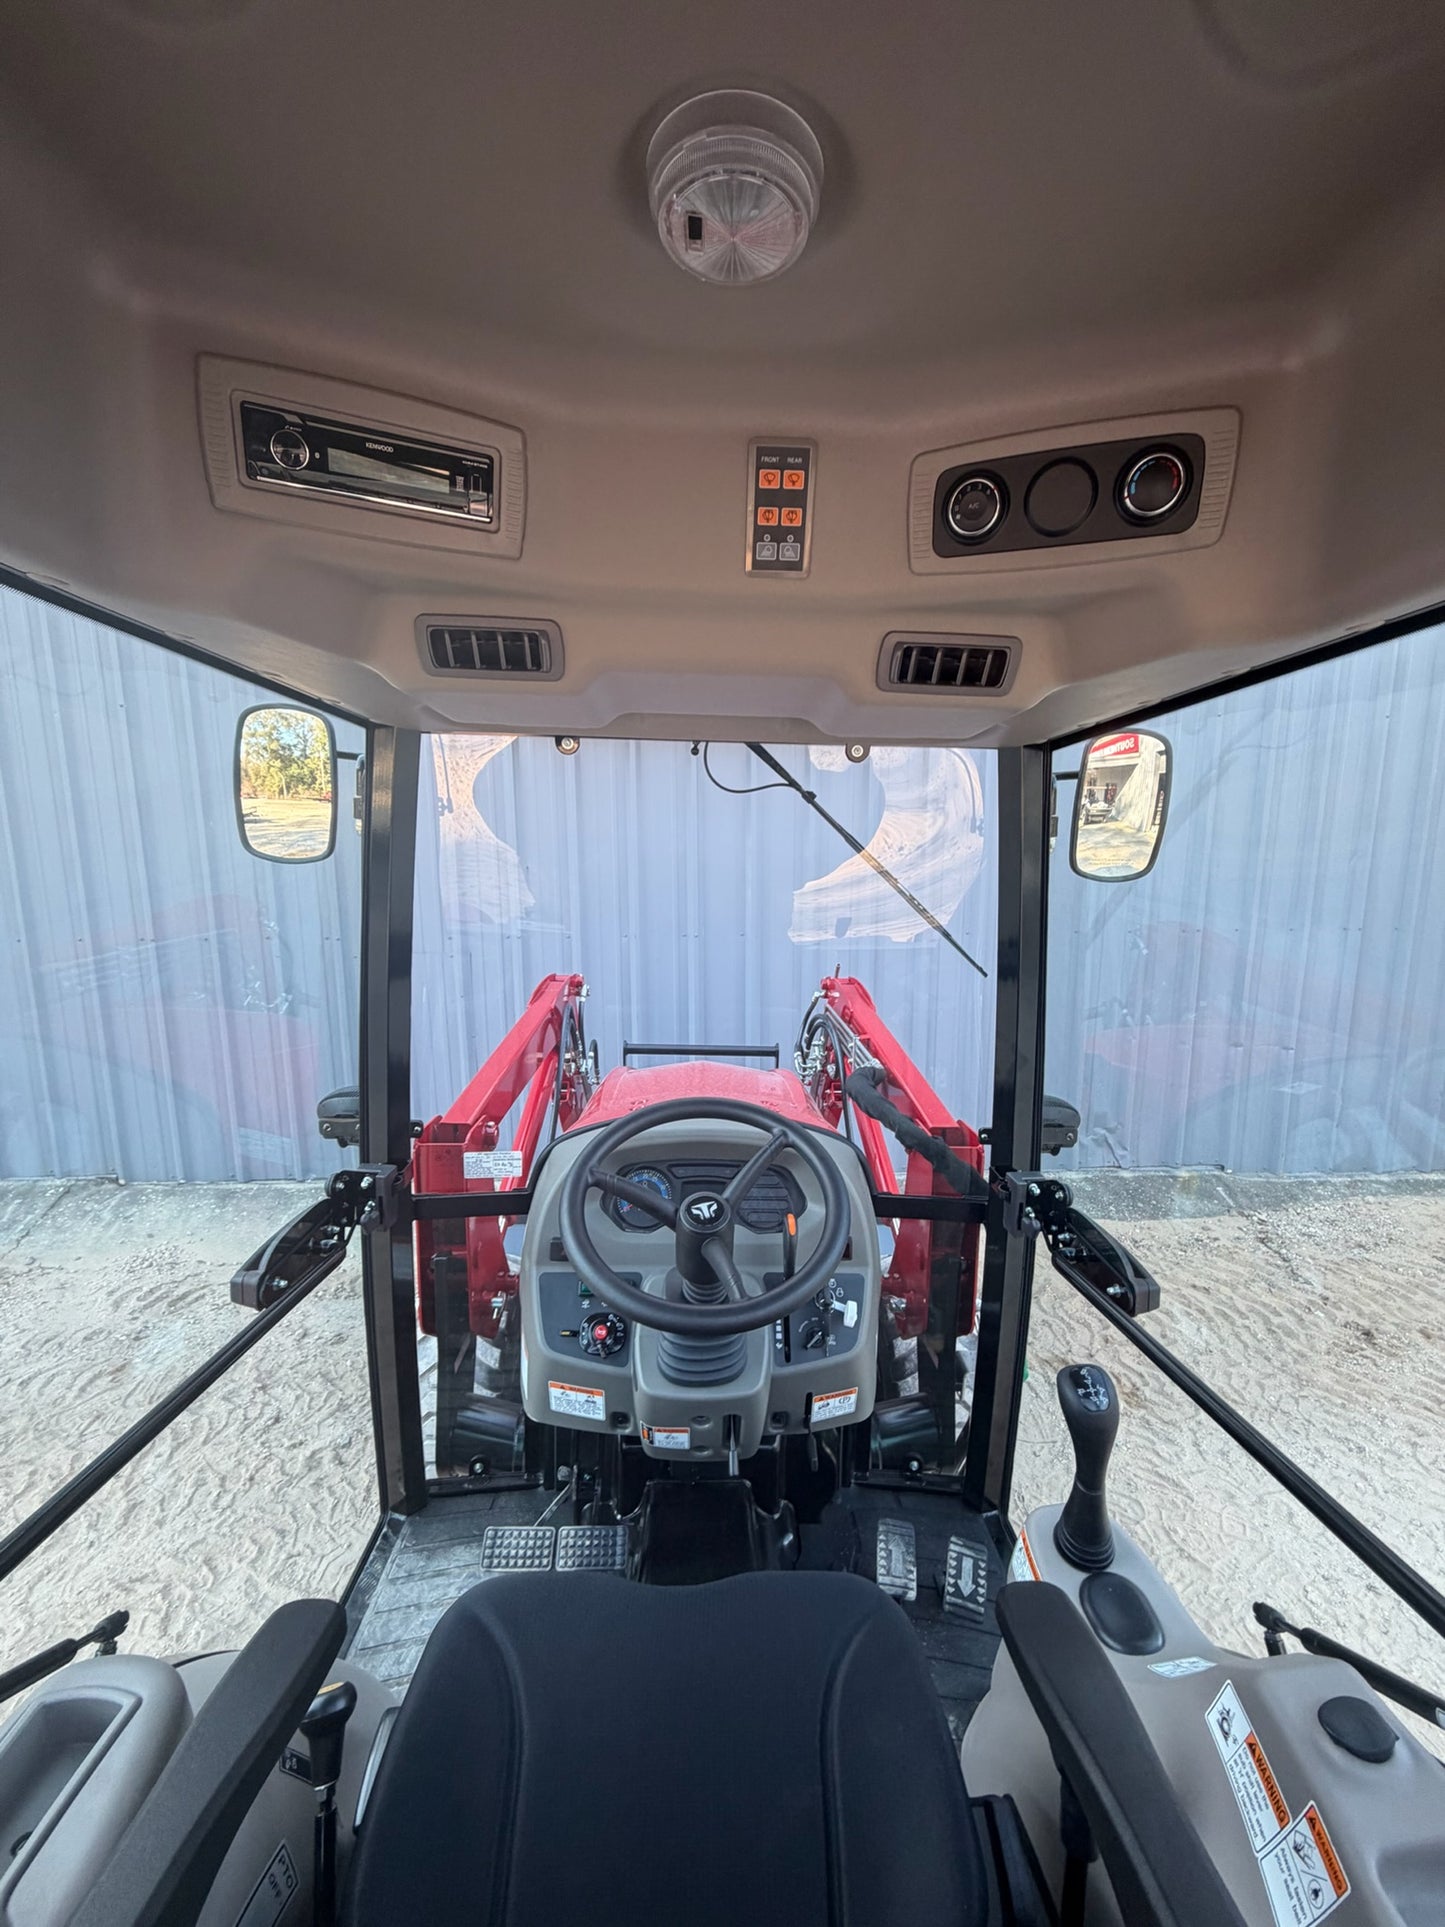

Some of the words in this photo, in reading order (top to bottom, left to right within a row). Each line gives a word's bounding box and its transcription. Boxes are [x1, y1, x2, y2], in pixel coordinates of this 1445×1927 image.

[365, 441, 394, 454] KENWOOD
[761, 456, 779, 464] FRONT
[787, 456, 802, 464] REAR
[1255, 1756, 1287, 1822] WARNING
[278, 1854, 294, 1889] PTO
[1315, 1830, 1343, 1890] WARNING
